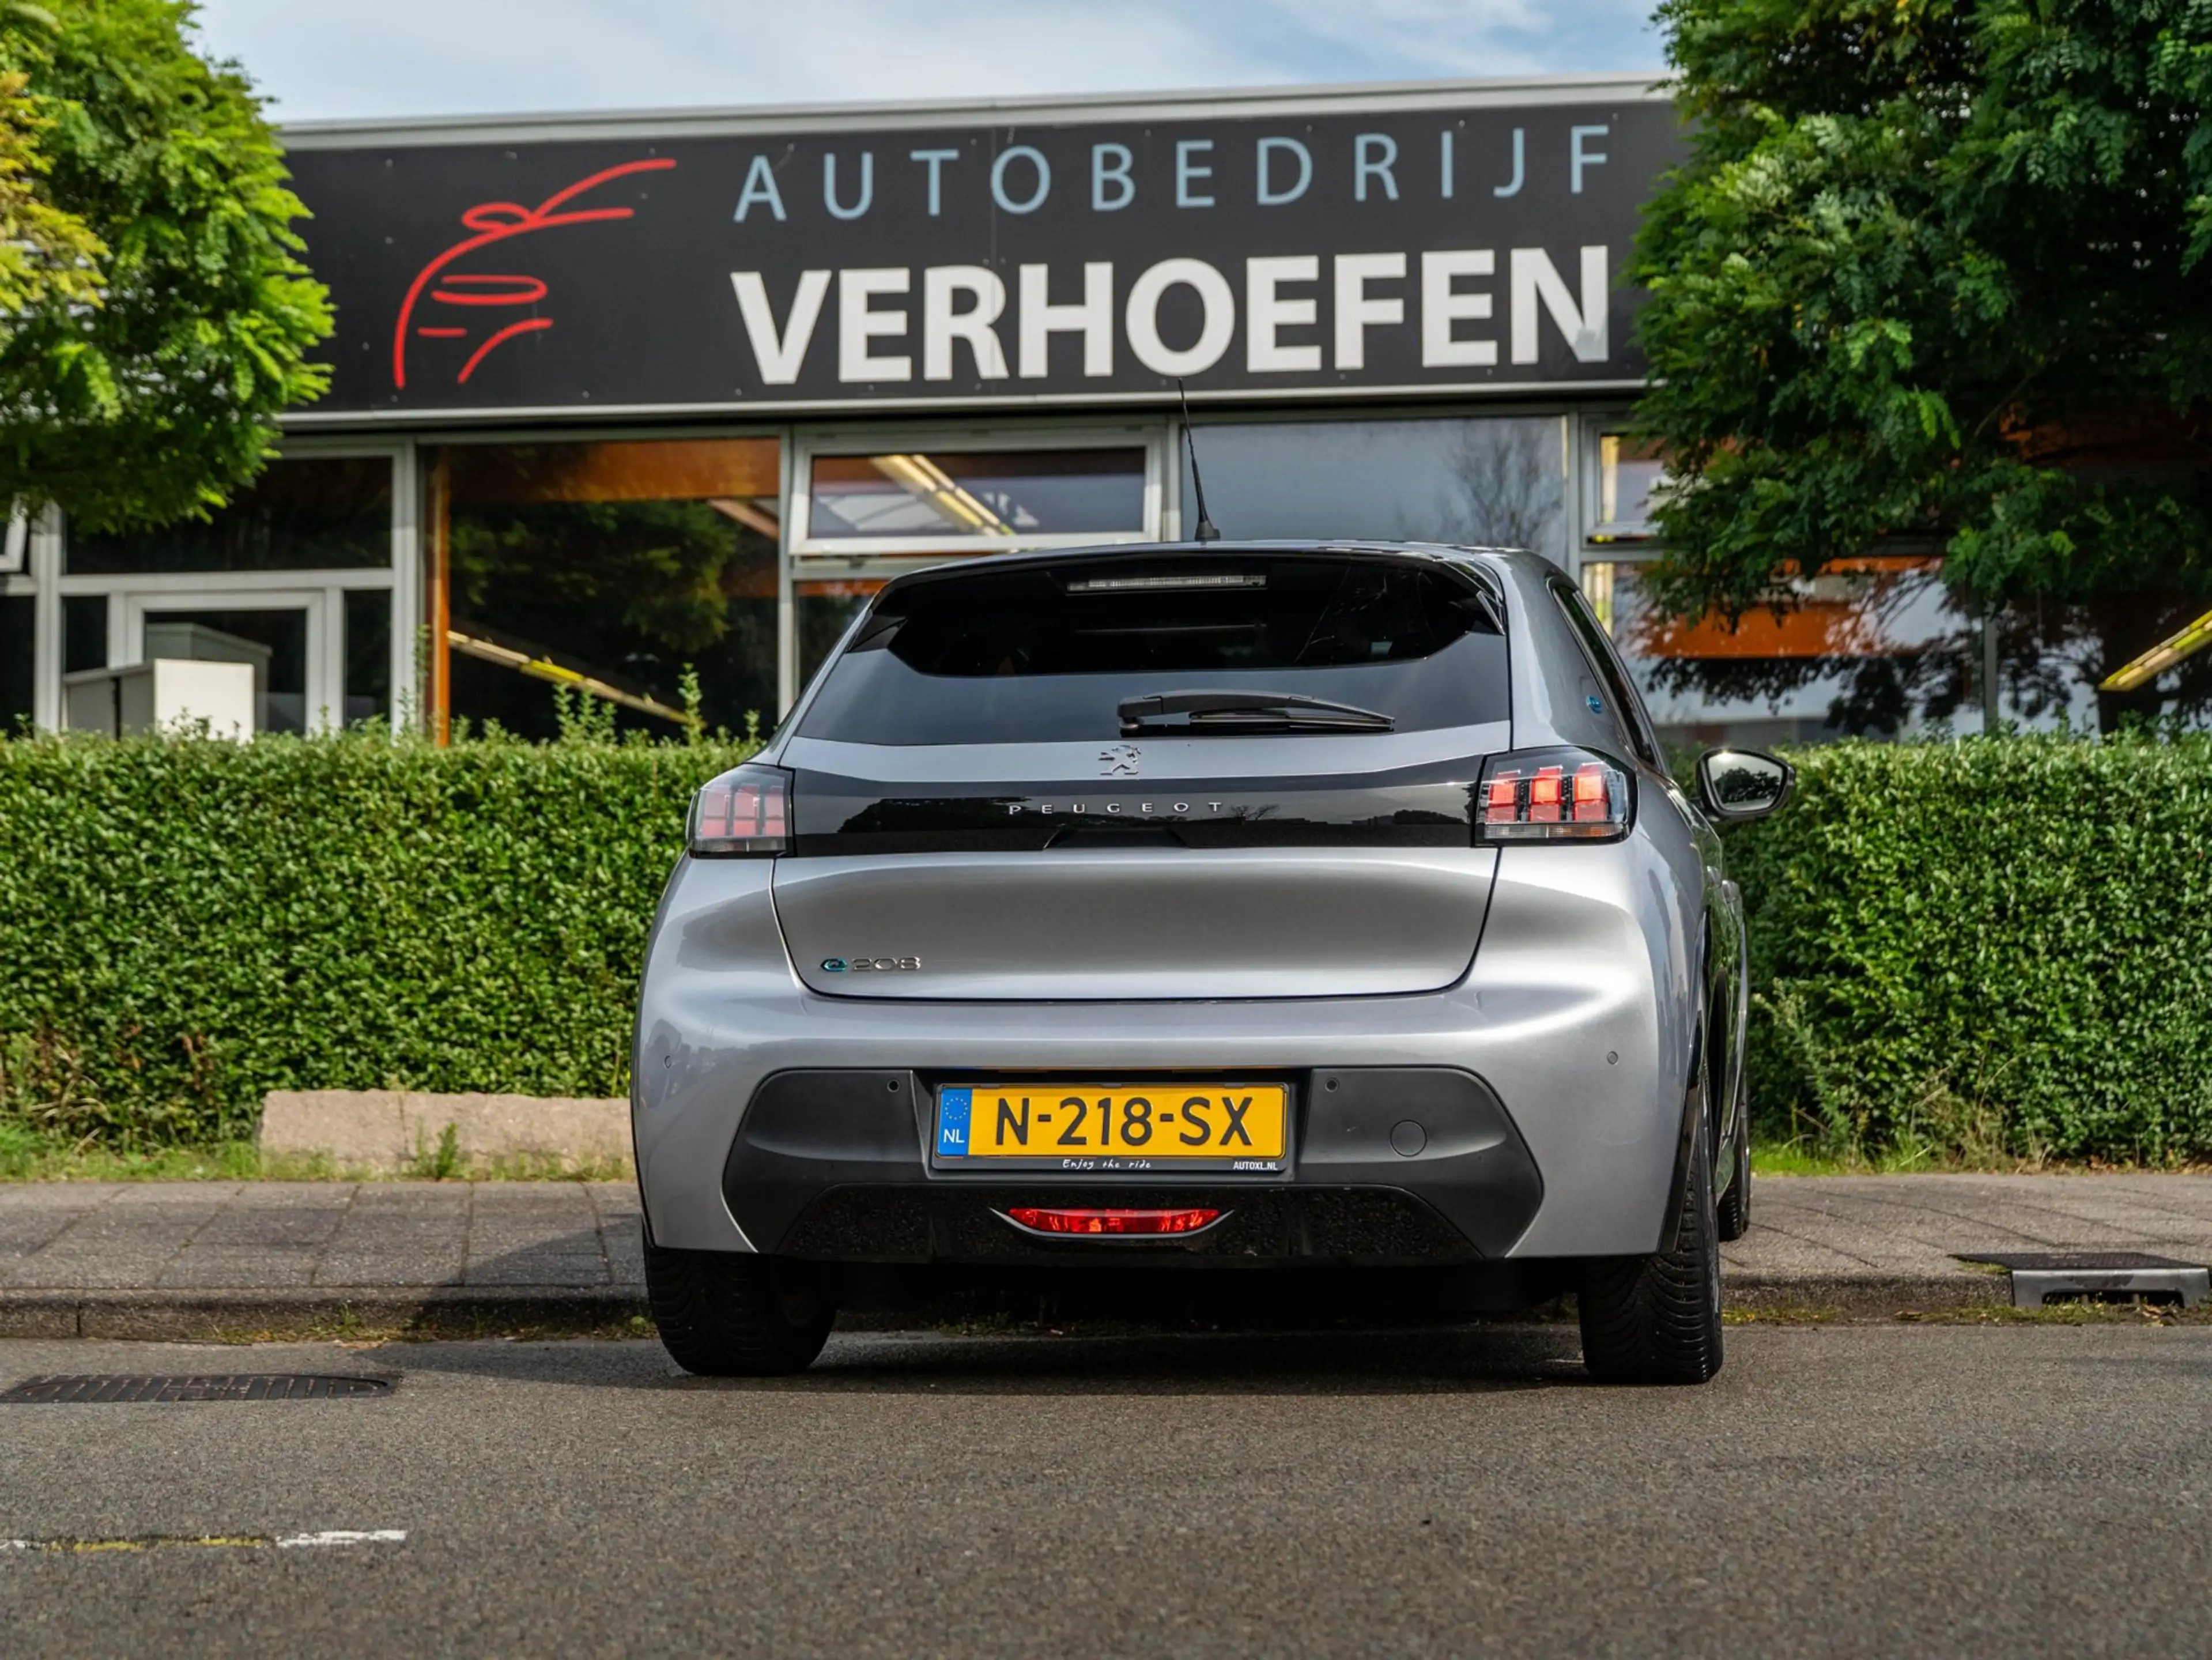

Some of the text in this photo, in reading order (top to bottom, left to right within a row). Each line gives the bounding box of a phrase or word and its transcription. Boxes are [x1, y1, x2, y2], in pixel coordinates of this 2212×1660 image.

[733, 124, 1610, 222] AUTOBEDRIJF
[731, 244, 1609, 386] VERHOEFEN
[1009, 802, 1221, 815] PEUGEOT
[995, 1096, 1253, 1146] N-218-SX
[943, 1129, 964, 1143] NL
[1062, 1159, 1152, 1169] Enjoy the ride
[1233, 1161, 1278, 1171] AUTOXL.NL
